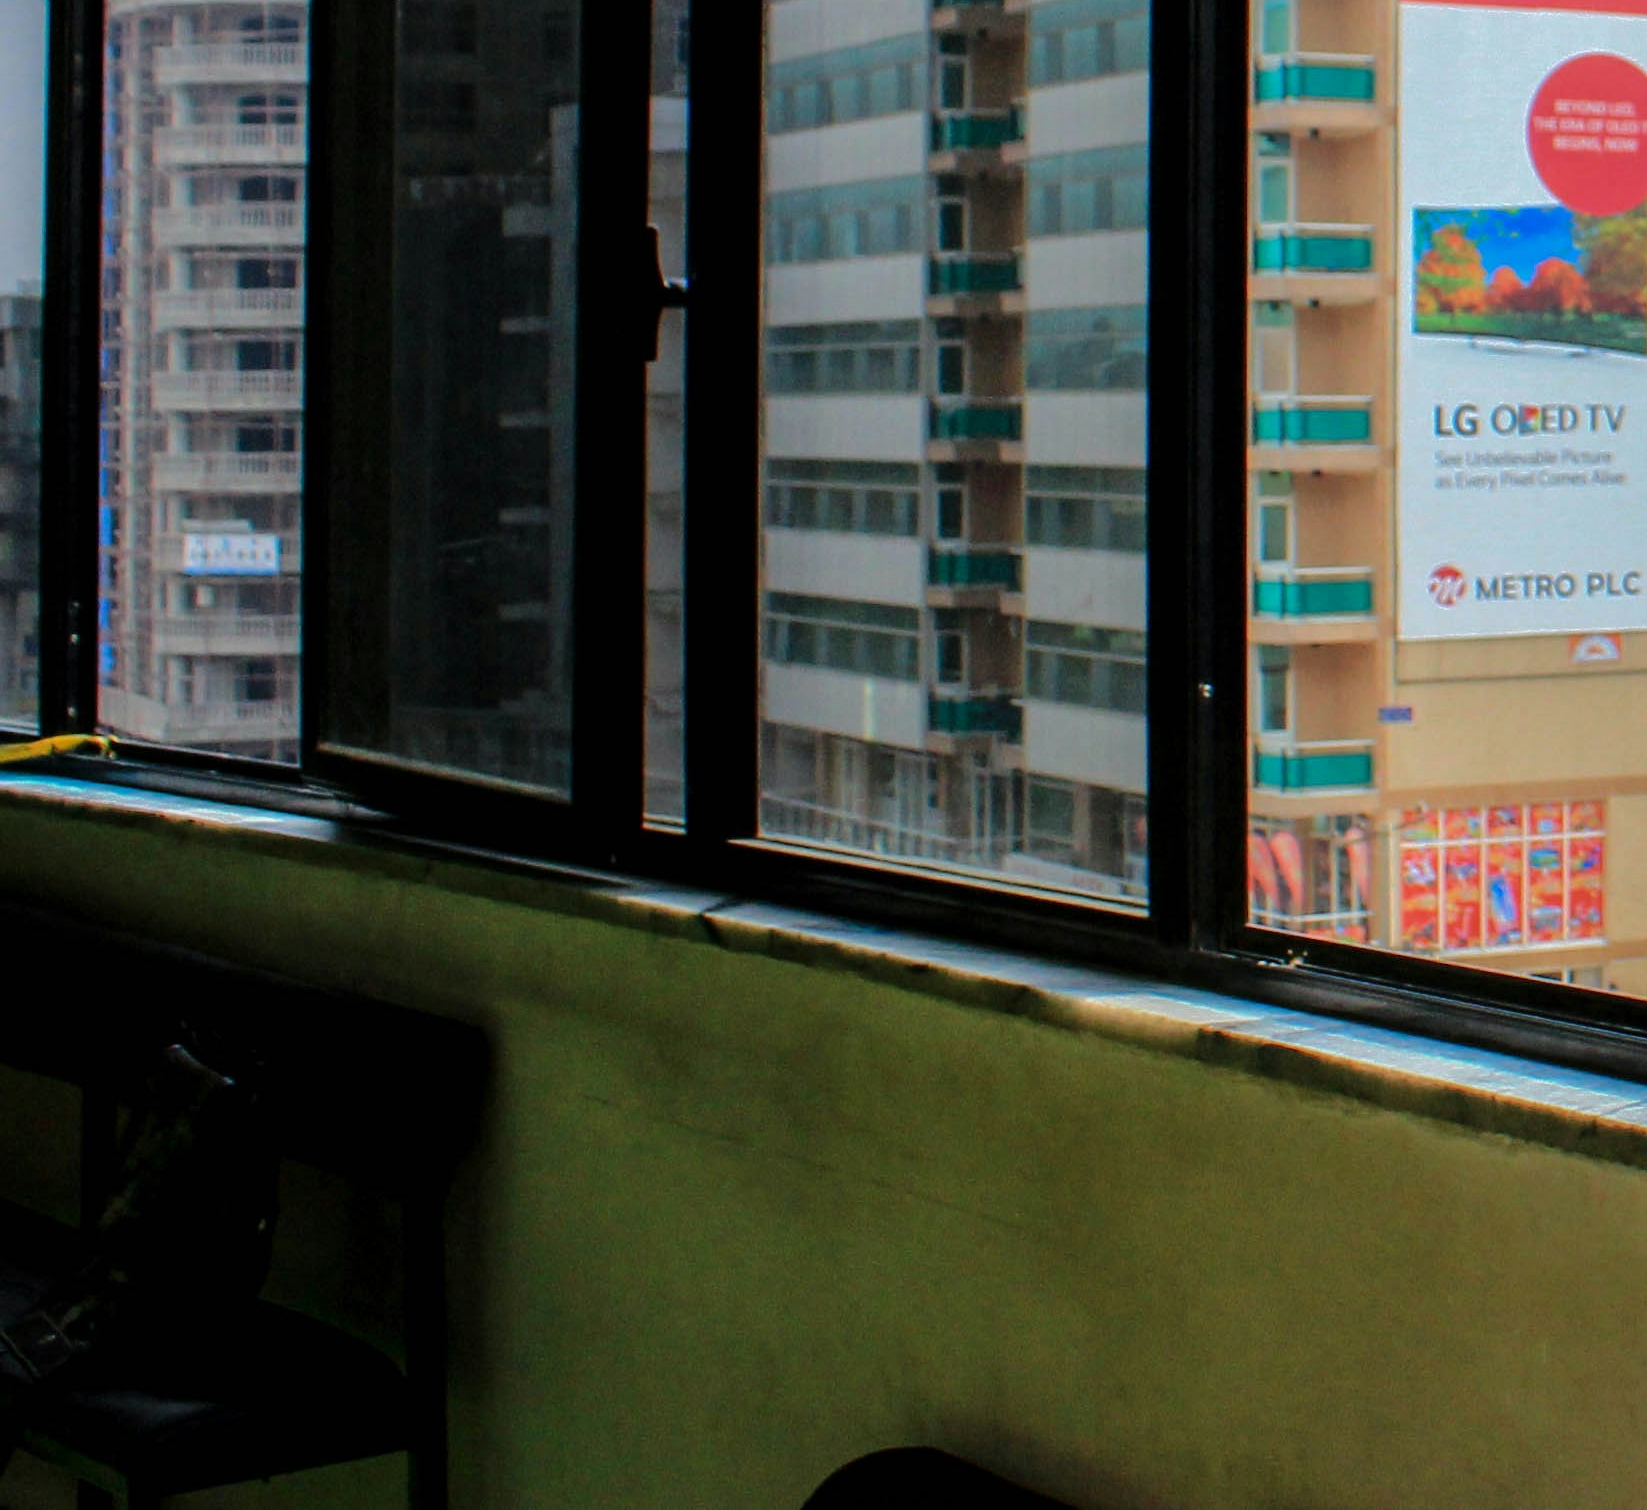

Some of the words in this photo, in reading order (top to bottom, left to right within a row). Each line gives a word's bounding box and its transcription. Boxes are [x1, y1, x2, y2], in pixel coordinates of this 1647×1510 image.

[1554, 99, 1606, 115] BEYOND
[1533, 116, 1558, 132] THE
[1560, 117, 1585, 132] ERA
[1587, 118, 1604, 133] OF
[1606, 119, 1639, 135] OLED
[1604, 137, 1638, 152] NOW
[1434, 403, 1480, 437] LG
[1491, 403, 1580, 436] OLED
[1585, 402, 1626, 433] TV
[1435, 450, 1463, 465] See
[1466, 449, 1558, 466] Unbelievable
[1561, 448, 1614, 464] Picture
[1455, 472, 1497, 491] Every
[1501, 470, 1536, 486] Pixel
[1538, 470, 1588, 486] Comes
[1592, 469, 1626, 485] Alive
[1474, 573, 1578, 601] METRO
[1586, 570, 1642, 597] PLC
